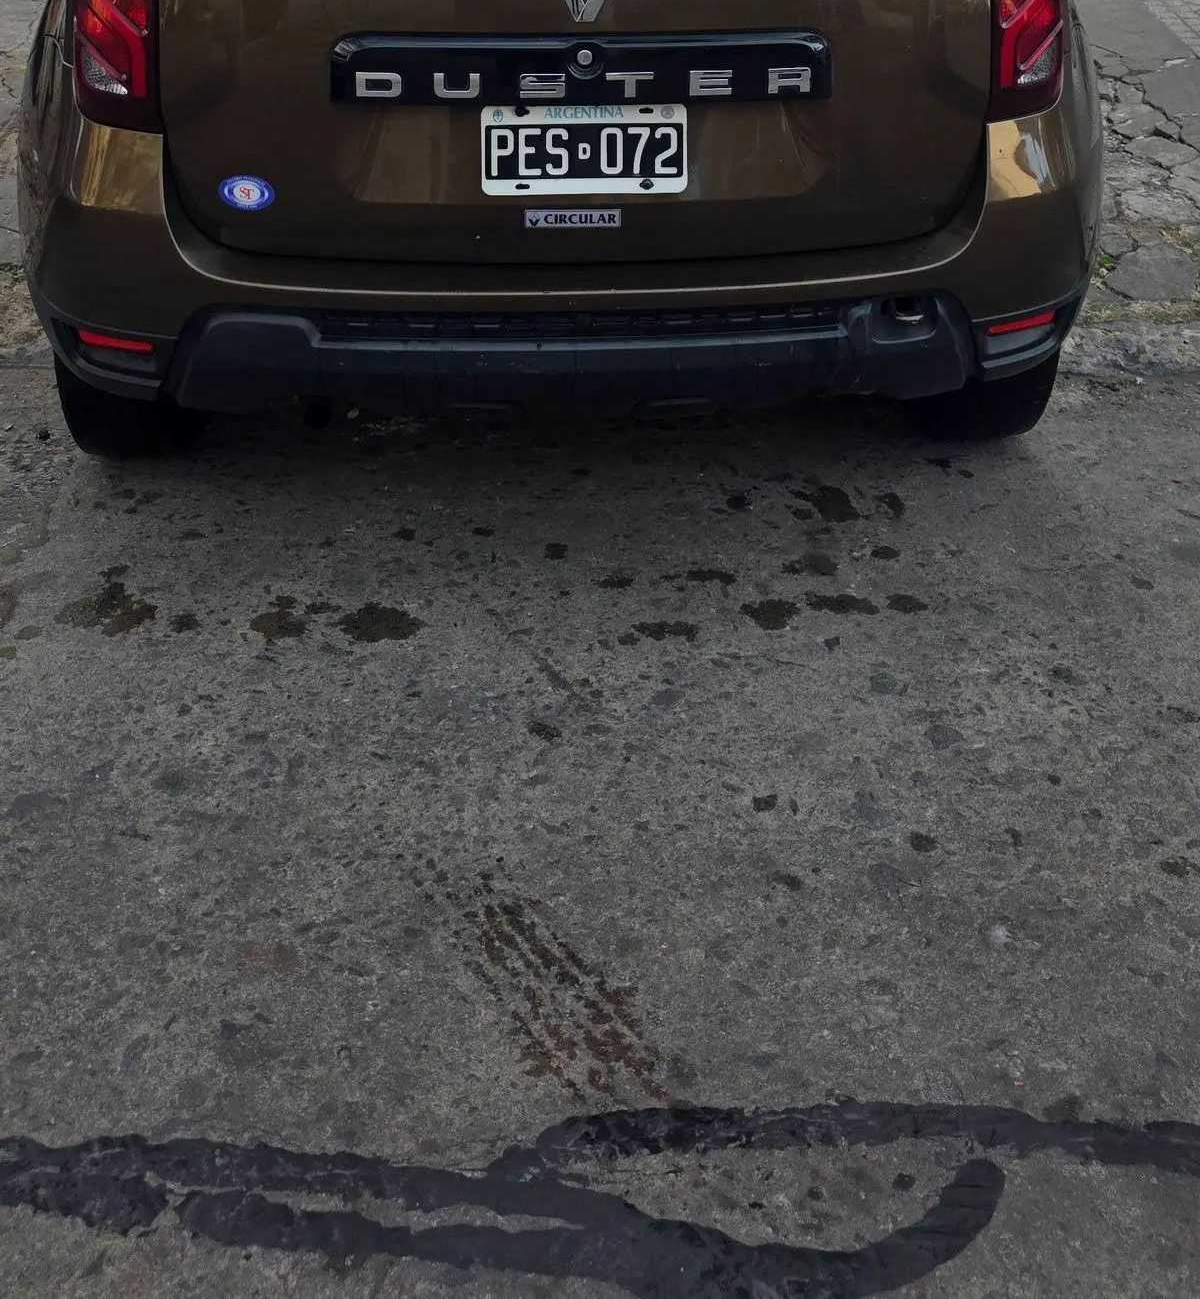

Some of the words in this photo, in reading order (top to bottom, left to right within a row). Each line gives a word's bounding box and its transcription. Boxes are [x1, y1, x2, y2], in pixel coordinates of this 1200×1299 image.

[355, 66, 812, 99] DUSTER
[544, 106, 624, 119] ARGENTINA
[490, 127, 569, 176] PES
[600, 127, 678, 175] 072
[543, 214, 617, 224] CIRCULAR
